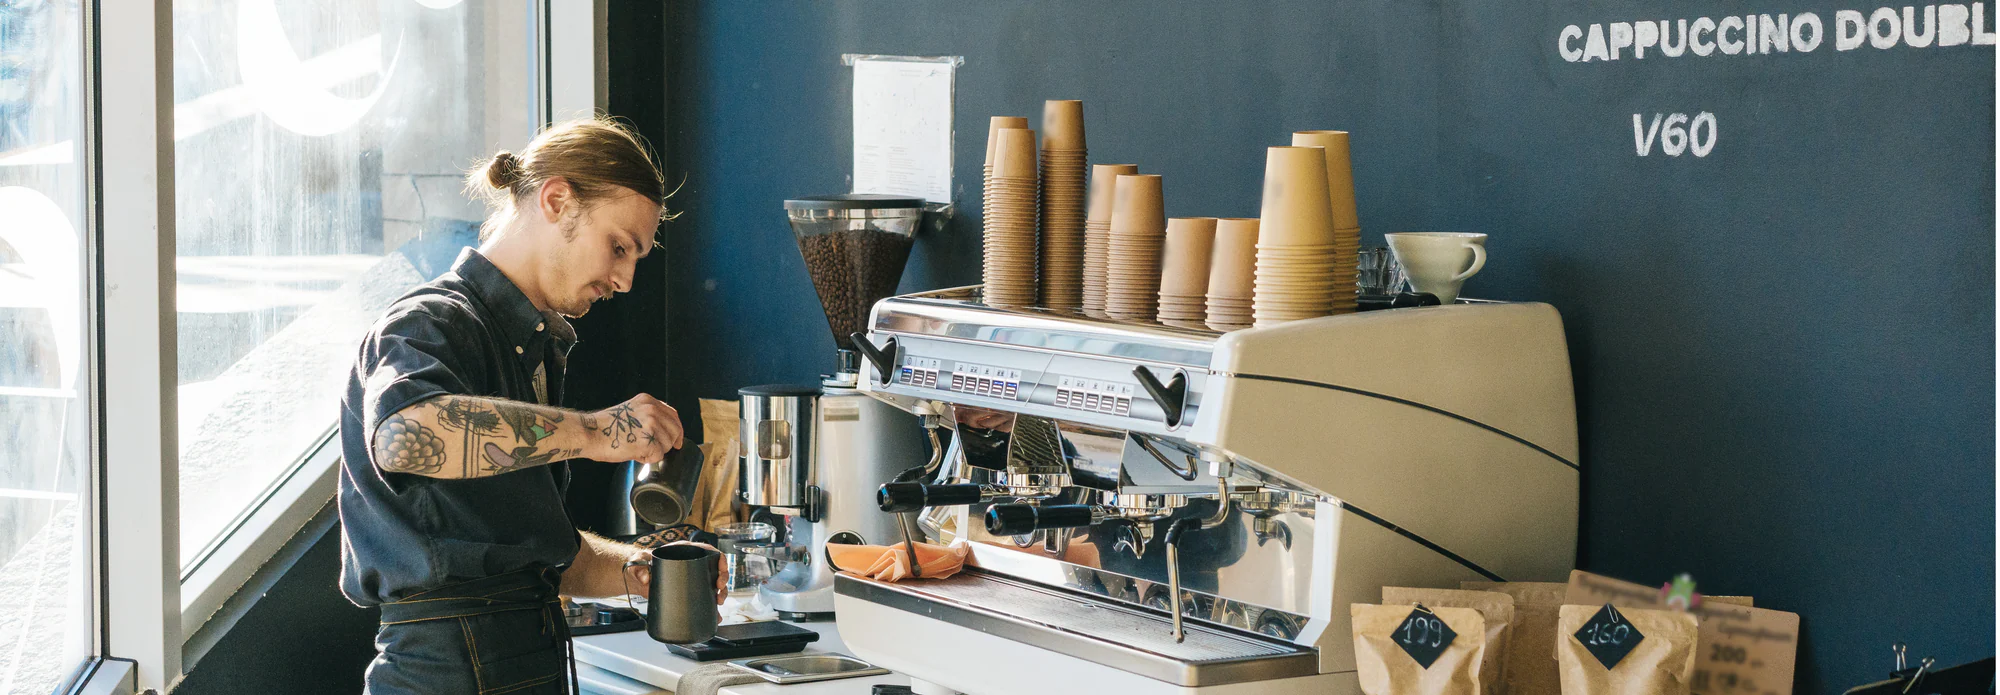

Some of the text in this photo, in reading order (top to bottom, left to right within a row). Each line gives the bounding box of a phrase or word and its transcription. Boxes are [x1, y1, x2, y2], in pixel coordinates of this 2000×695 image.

[1558, 2, 1995, 62] CAPPUCCINO DOUBL
[1633, 110, 1717, 157] V60
[1403, 617, 1441, 647] 199
[1587, 623, 1629, 645] 160
